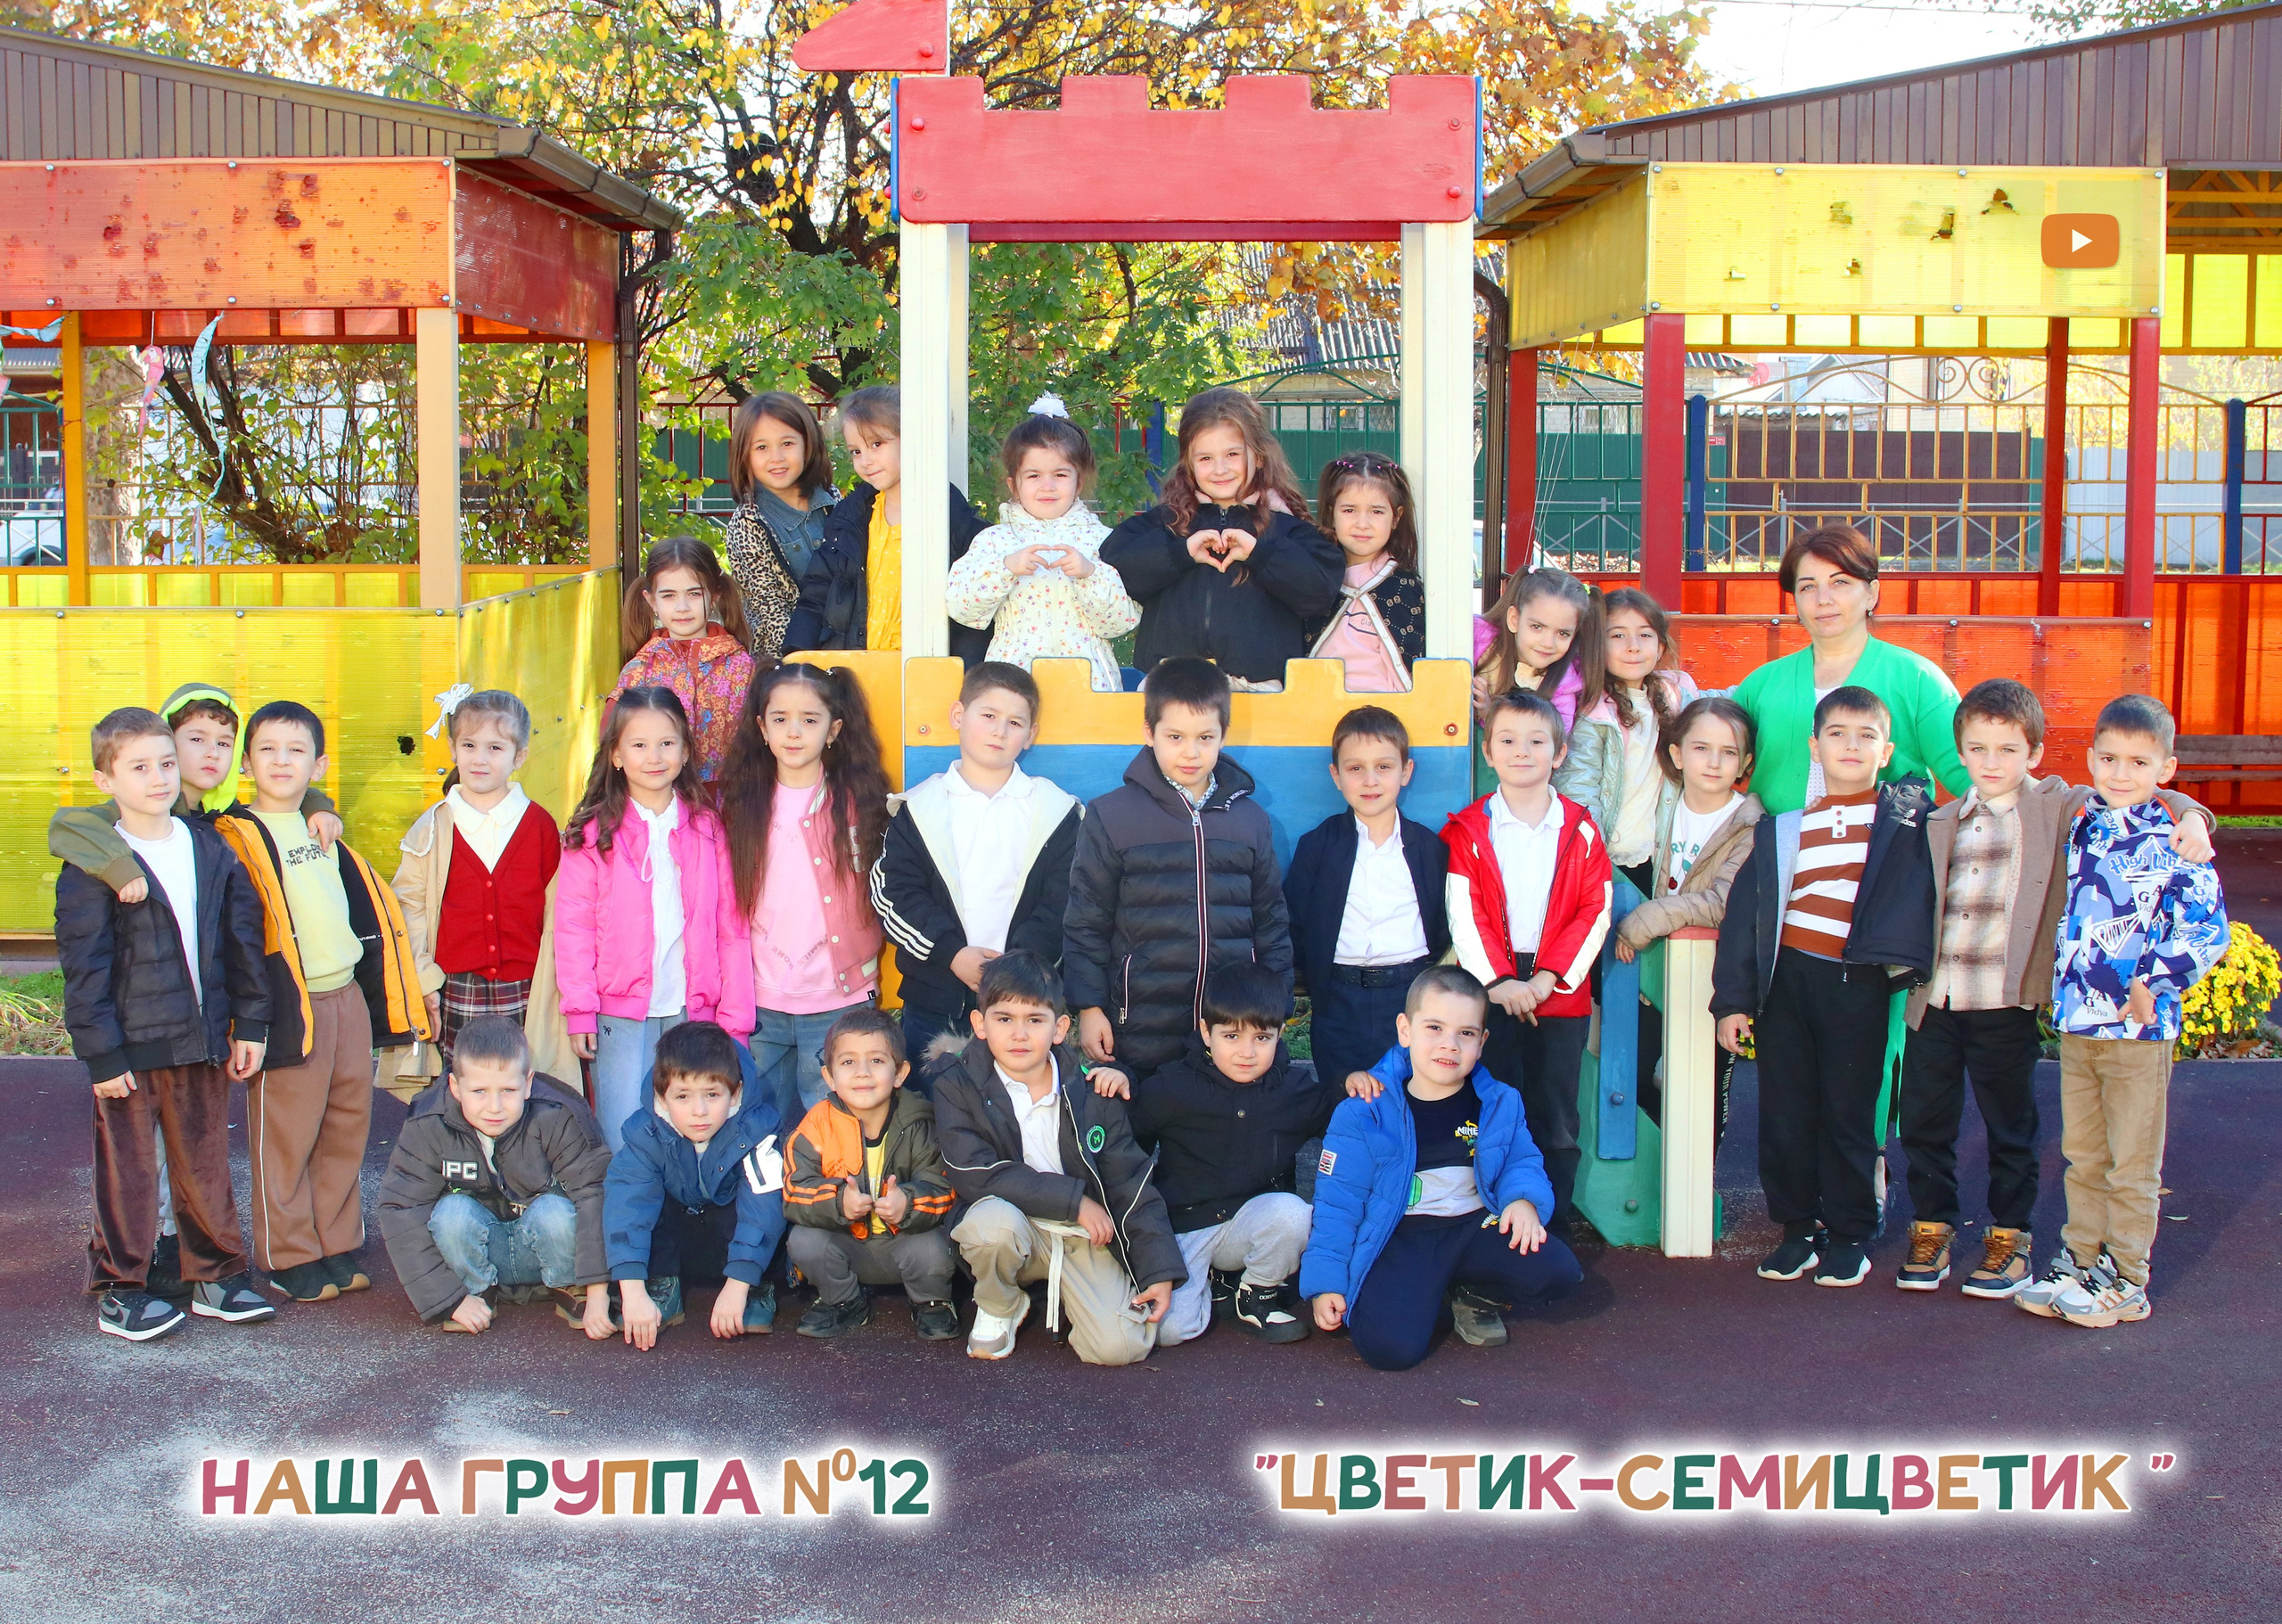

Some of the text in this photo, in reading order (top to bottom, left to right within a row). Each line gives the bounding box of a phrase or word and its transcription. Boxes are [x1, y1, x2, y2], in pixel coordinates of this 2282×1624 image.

[2108, 851, 2178, 875] High Vib
[2086, 1007, 2108, 1018] Vidya
